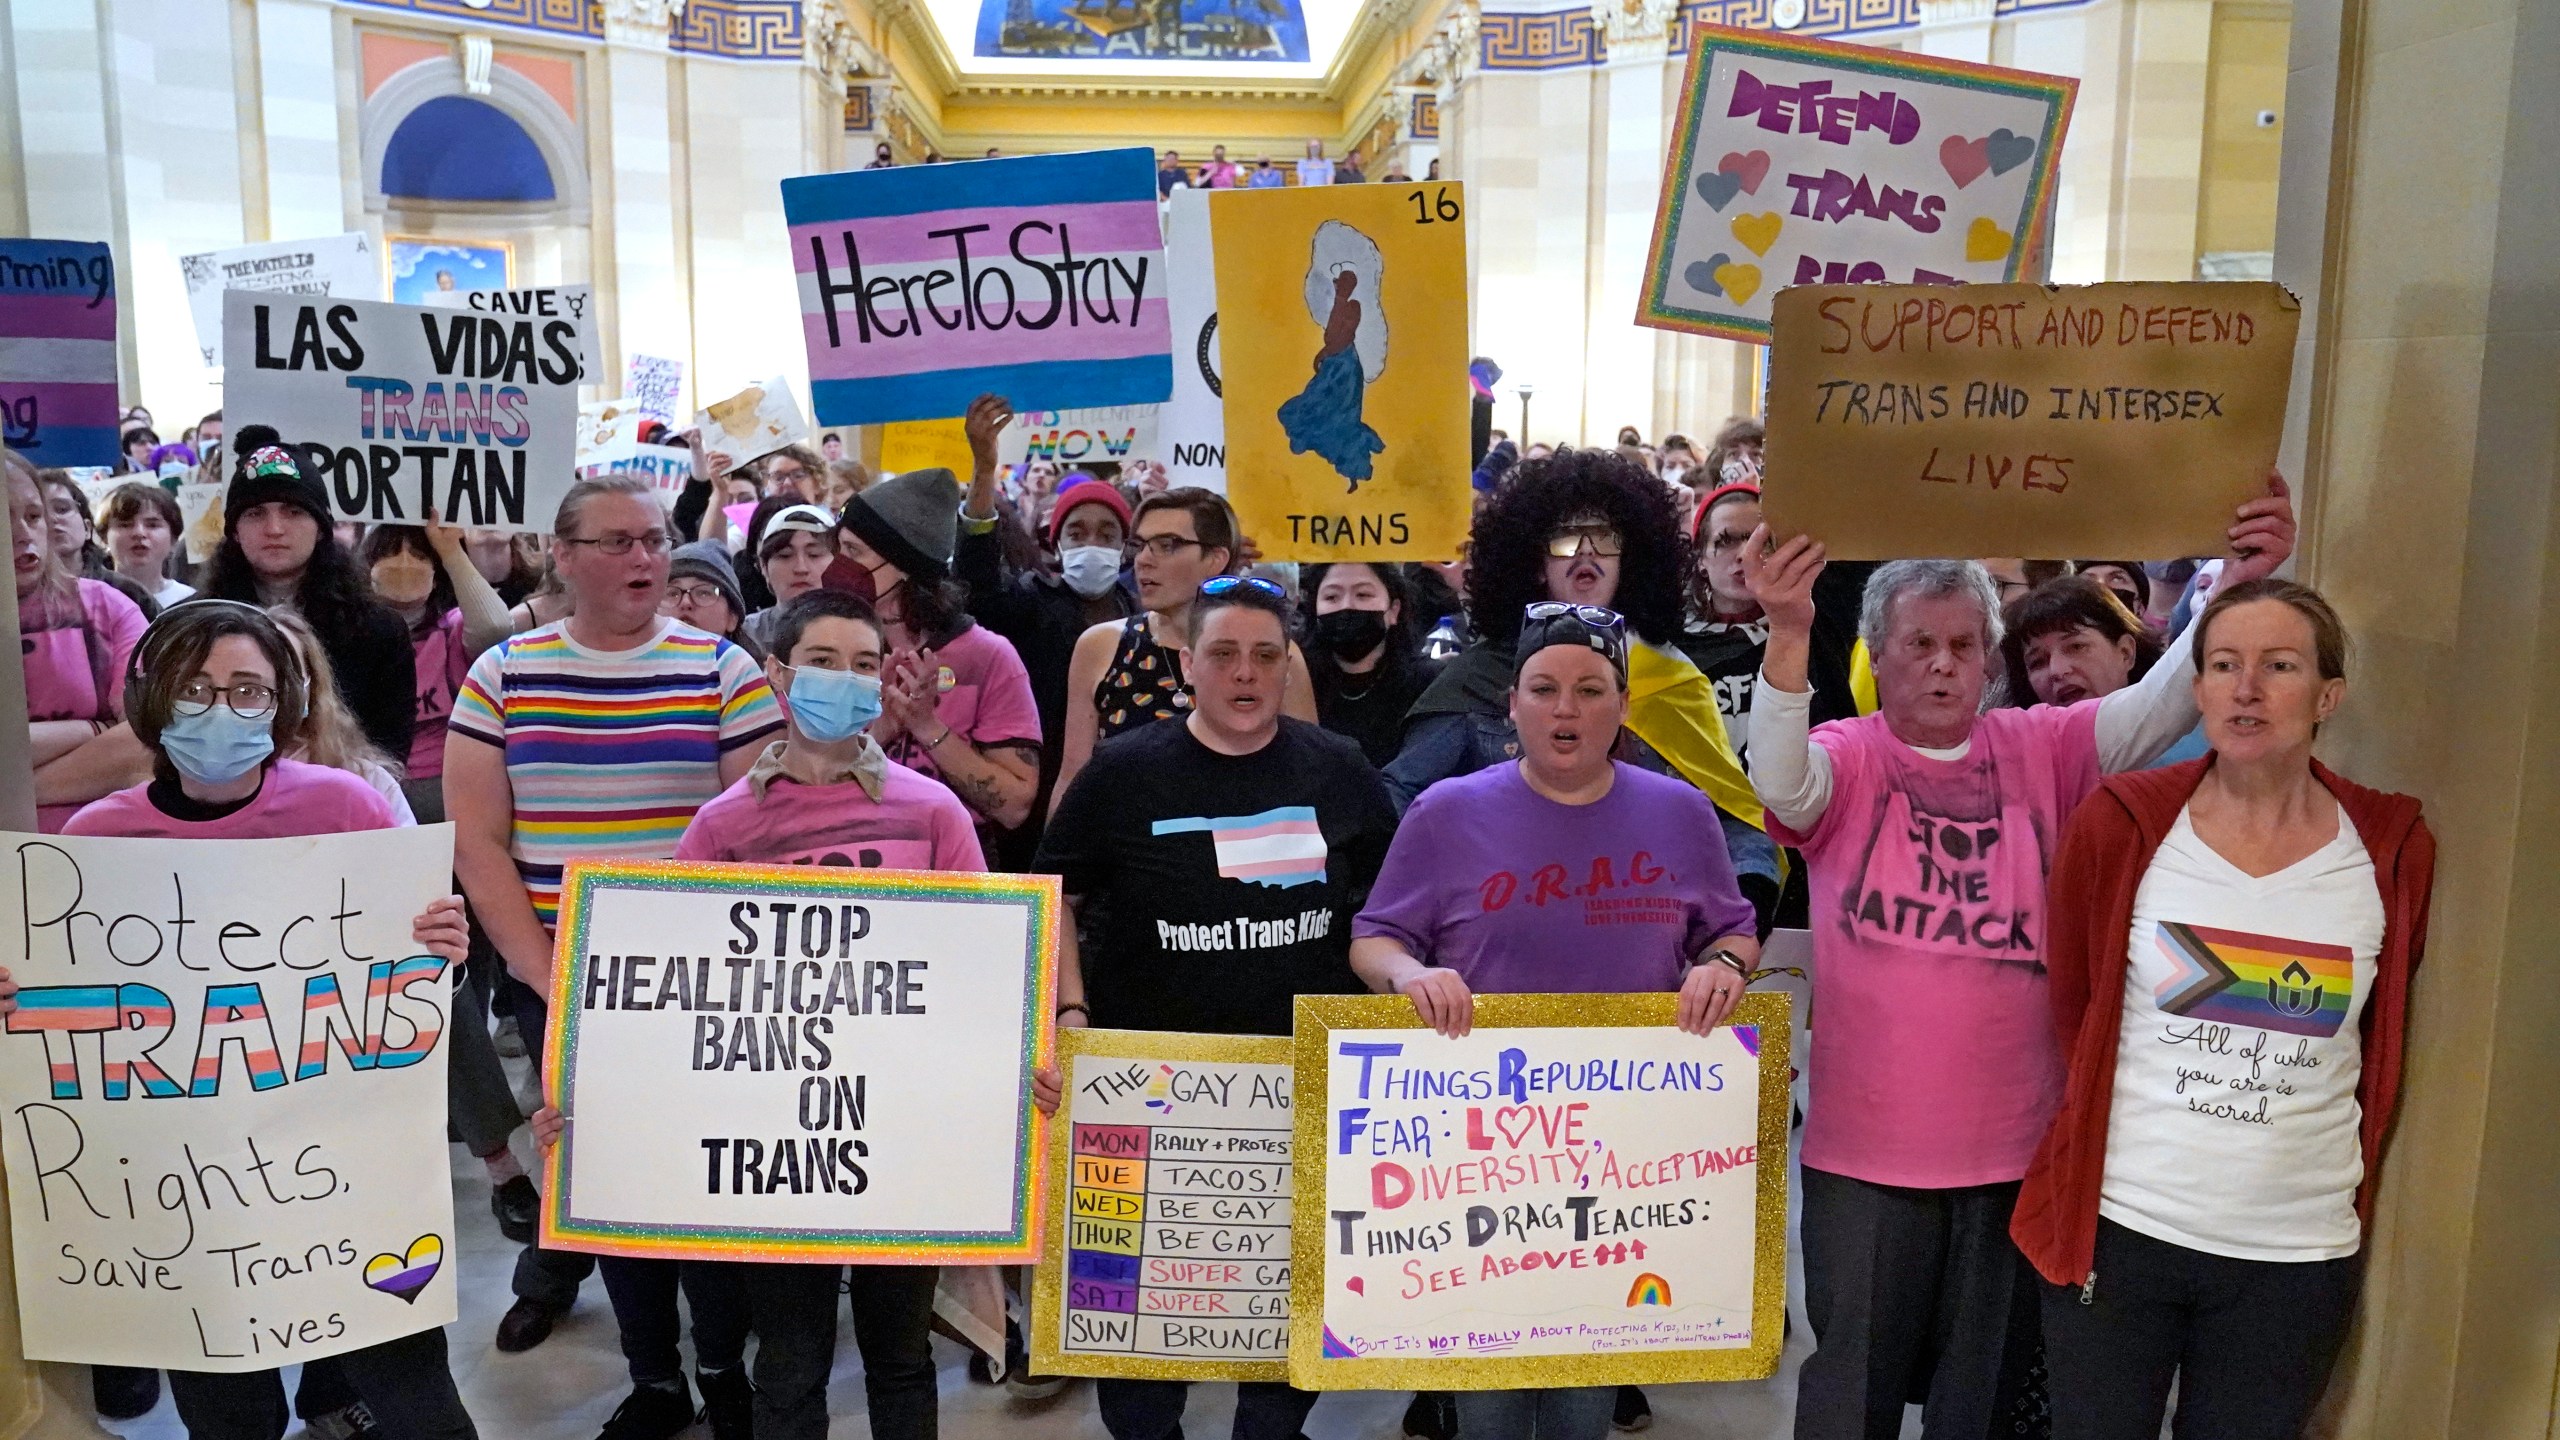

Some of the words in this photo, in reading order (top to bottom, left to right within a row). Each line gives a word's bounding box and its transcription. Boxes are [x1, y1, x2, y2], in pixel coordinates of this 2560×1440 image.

[1727, 69, 1921, 145] DEFEND
[1408, 187, 1460, 224] 16
[1786, 169, 1946, 234] TRANS
[469, 290, 558, 316] SAVE
[1819, 297, 2024, 354] SUPPORT
[2037, 306, 2103, 347] AND
[2118, 303, 2255, 347] DEFEND
[254, 305, 364, 371] LAS
[421, 312, 579, 385] VIDAS
[346, 376, 530, 447] TRANS
[1815, 379, 1949, 425] TRANS
[1963, 381, 2029, 419] AND
[2049, 387, 2224, 422] INTERSEX
[1024, 427, 1136, 462] NOW
[308, 442, 527, 525] PORTAN
[1921, 447, 2073, 493] LIVES
[1286, 513, 1409, 546] TRANS
[1478, 851, 1677, 913] D.R.A.G.
[1918, 854, 1989, 904] THE
[16, 842, 374, 971] Protect
[728, 901, 871, 959] STOP
[1156, 919, 1234, 951] Protect
[1236, 917, 1296, 950] Trans
[1297, 907, 1333, 942] Kids
[1856, 889, 2034, 950] ATTACK
[584, 954, 928, 1016] HEALTHCARE
[5, 954, 450, 1099] TRANS
[692, 1015, 833, 1072] BANS
[2158, 1022, 2232, 1055] All
[2239, 1032, 2266, 1079] of
[2274, 1038, 2321, 1068] who
[798, 1075, 866, 1132] ON
[1082, 1063, 1150, 1105] THE
[1171, 1070, 1238, 1107] GAY
[2176, 1066, 2222, 1094] you
[2230, 1078, 2270, 1092] are
[2276, 1078, 2297, 1096] is
[2188, 1096, 2274, 1126] sacred.
[701, 1137, 869, 1195] TRANS
[1081, 1131, 1139, 1152] MON
[1154, 1133, 1209, 1150] RALLY
[1077, 1161, 1130, 1185] TUE
[1164, 1167, 1282, 1193] TACOS!
[1076, 1191, 1139, 1215] WED
[1159, 1199, 1199, 1219] BE
[1212, 1200, 1275, 1220] GAY
[1075, 1221, 1132, 1248] THUR
[1158, 1228, 1201, 1250] BE
[1212, 1232, 1274, 1252] GAY
[58, 1243, 182, 1290] Save
[207, 1237, 358, 1288] Trans
[1150, 1259, 1242, 1283] SUPER
[1072, 1282, 1136, 1307] SAT
[1146, 1291, 1230, 1313] SUPER
[193, 1307, 346, 1359] Lives
[1071, 1314, 1128, 1343] SUN
[1163, 1322, 1290, 1350] BRUNCH
[1428, 1336, 1460, 1349] NOT
[1468, 1330, 1521, 1348] REALLY
[1530, 1326, 1573, 1339] ABOUT
